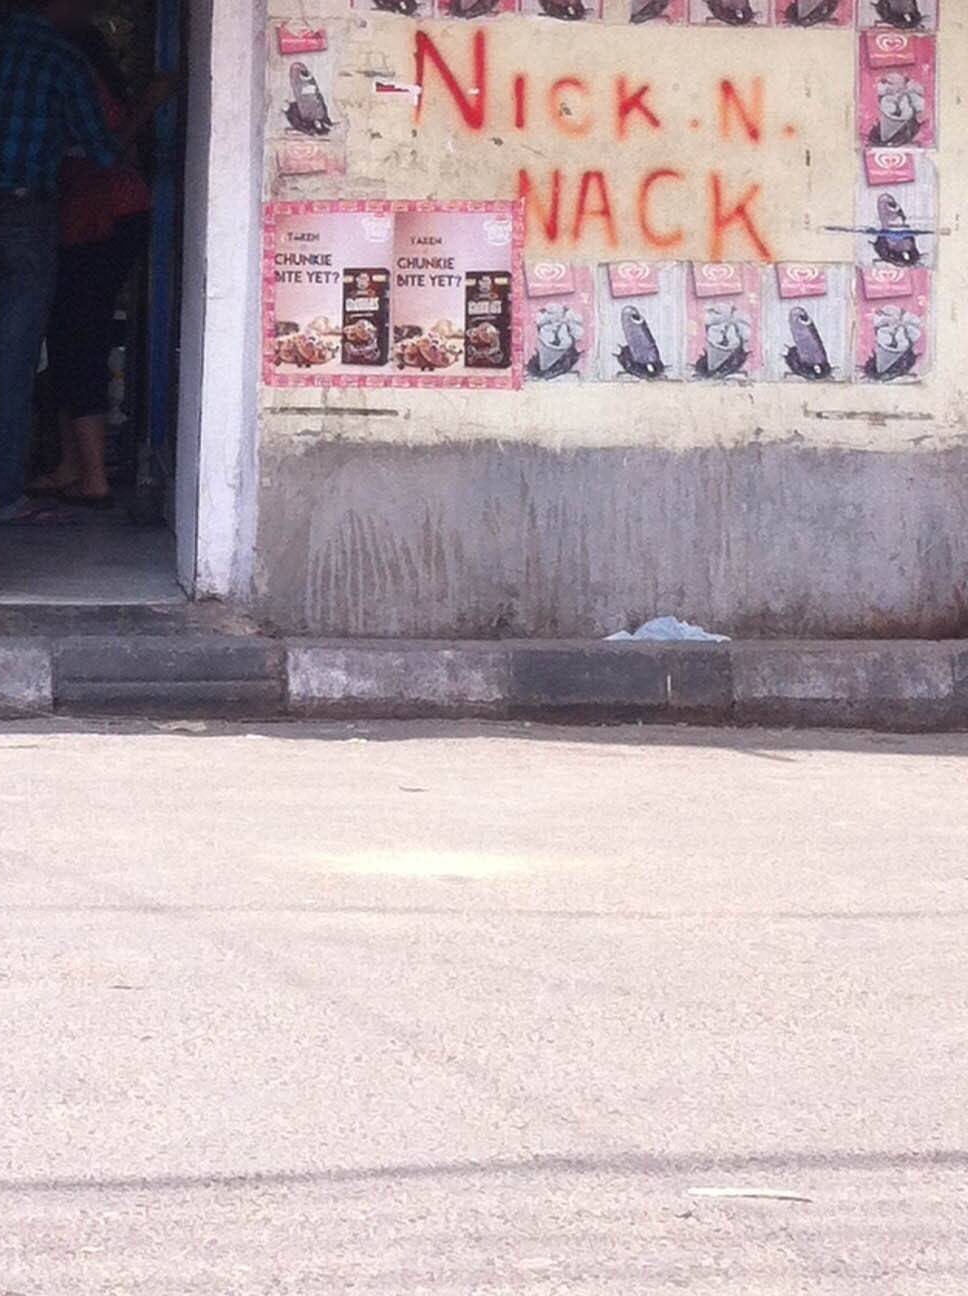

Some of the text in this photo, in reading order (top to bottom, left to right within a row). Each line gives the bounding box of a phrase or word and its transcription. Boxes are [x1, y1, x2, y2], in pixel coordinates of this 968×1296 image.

[517, 168, 775, 264] NACK
[274, 253, 332, 266] CHUNKIE
[396, 257, 455, 270] CHUNKIE
[306, 270, 341, 284] YET?
[396, 273, 462, 288] BITE YET?
